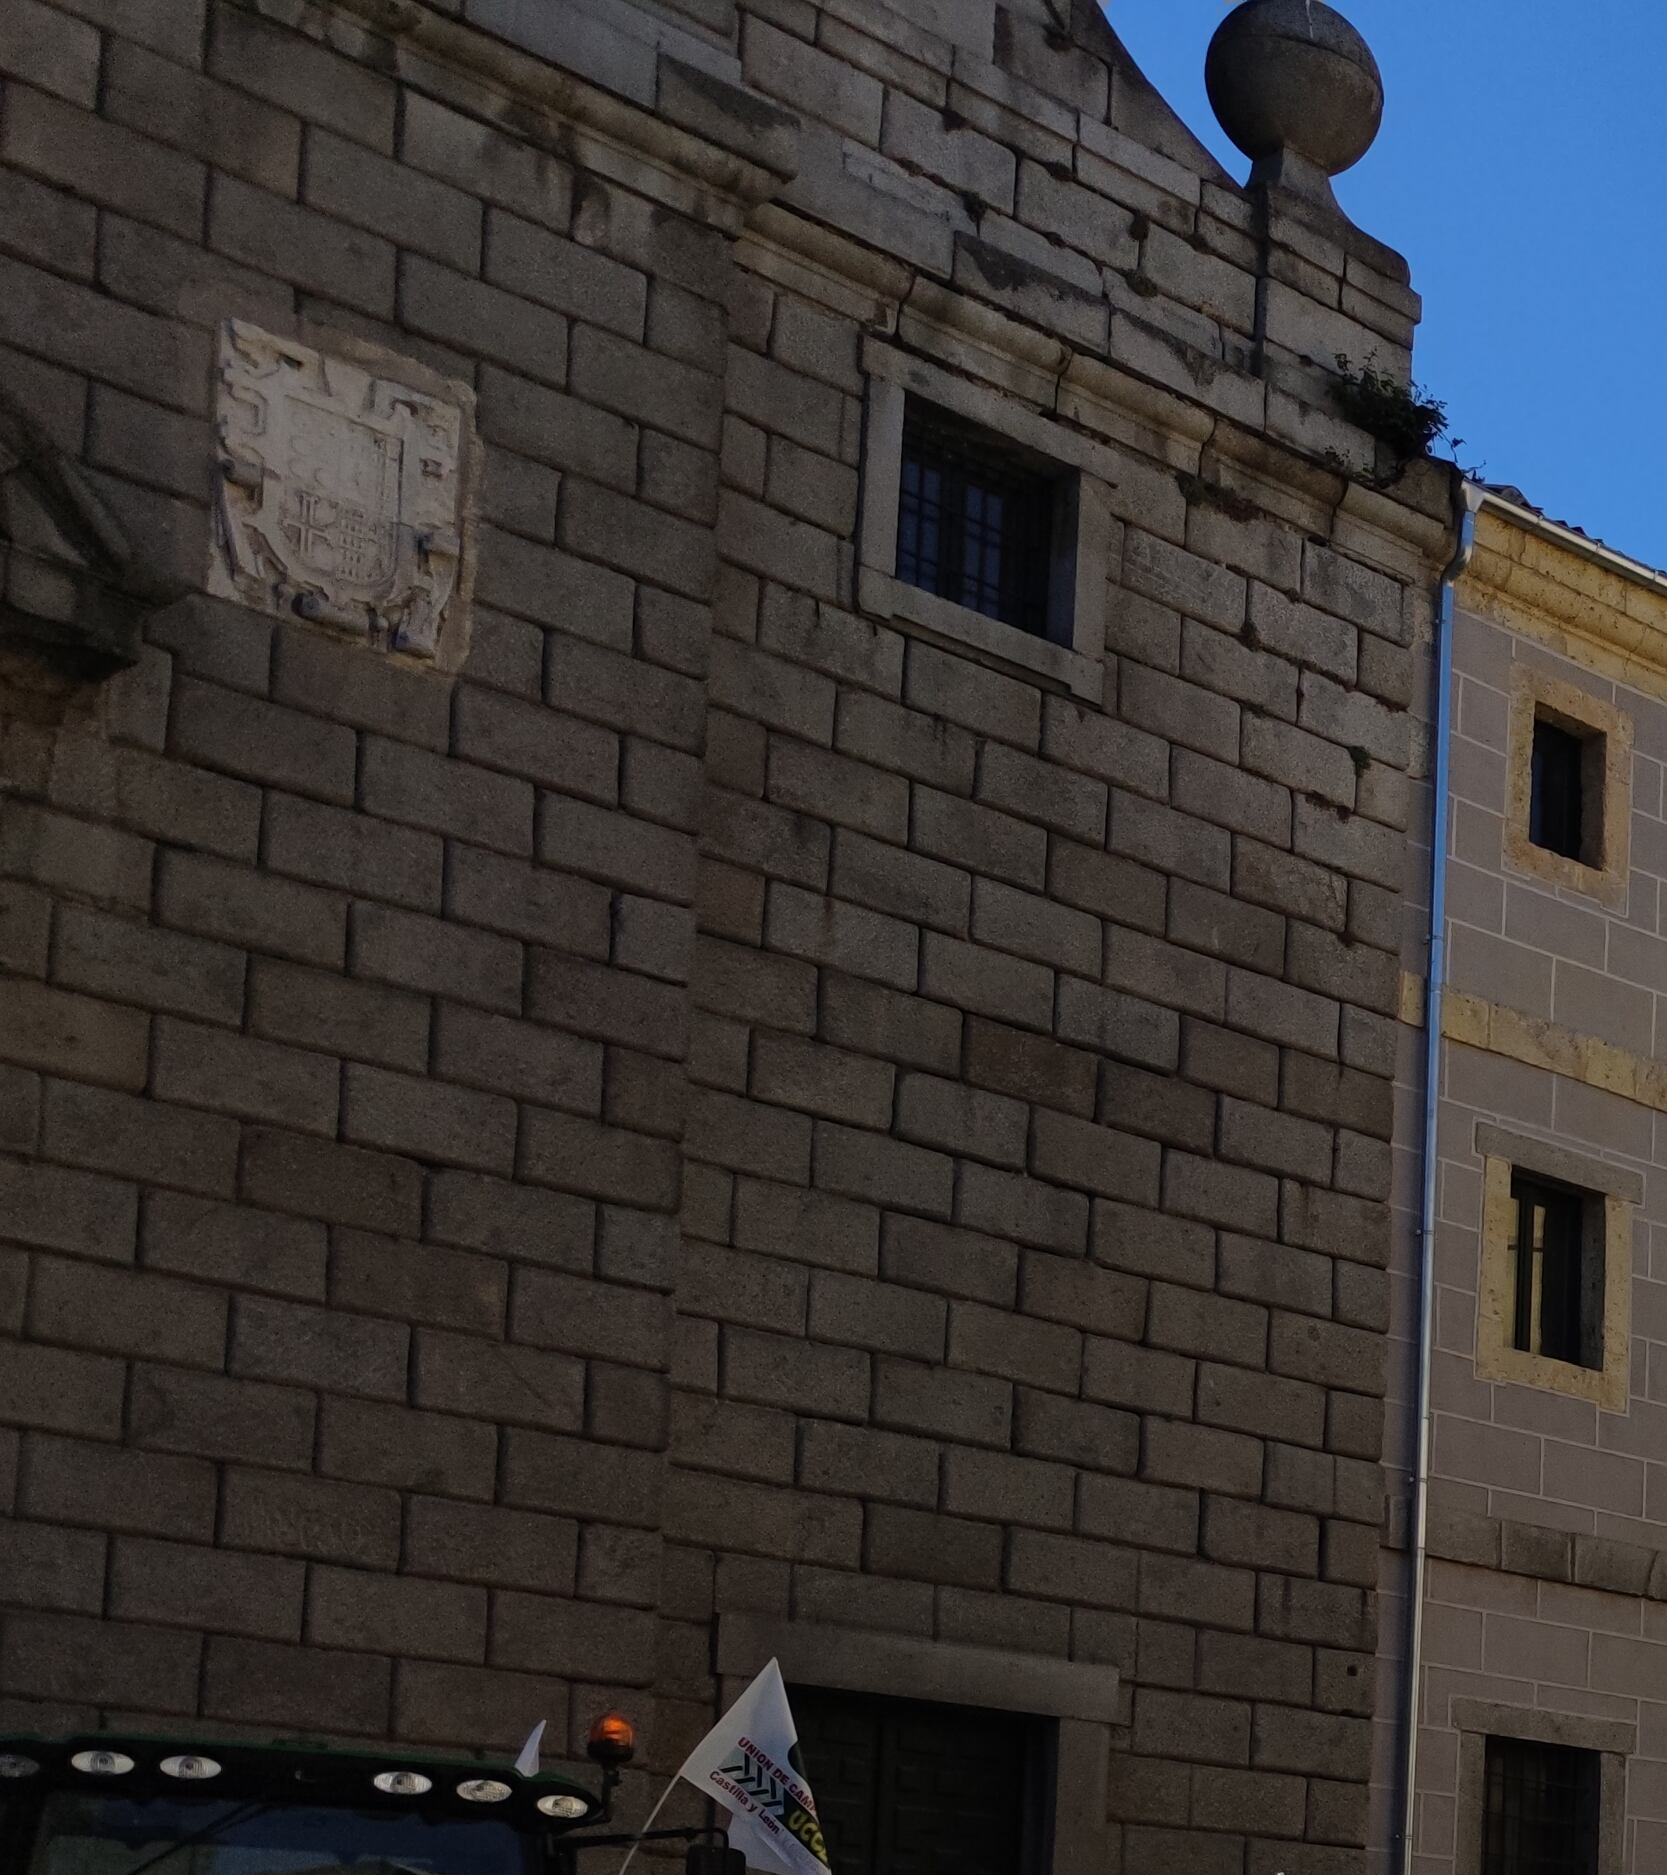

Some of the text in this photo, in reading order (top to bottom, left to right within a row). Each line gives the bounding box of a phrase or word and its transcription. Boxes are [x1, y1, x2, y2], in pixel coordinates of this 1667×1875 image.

[737, 1736, 790, 1786] UNION DE
[709, 1770, 782, 1835] Castilla y León
